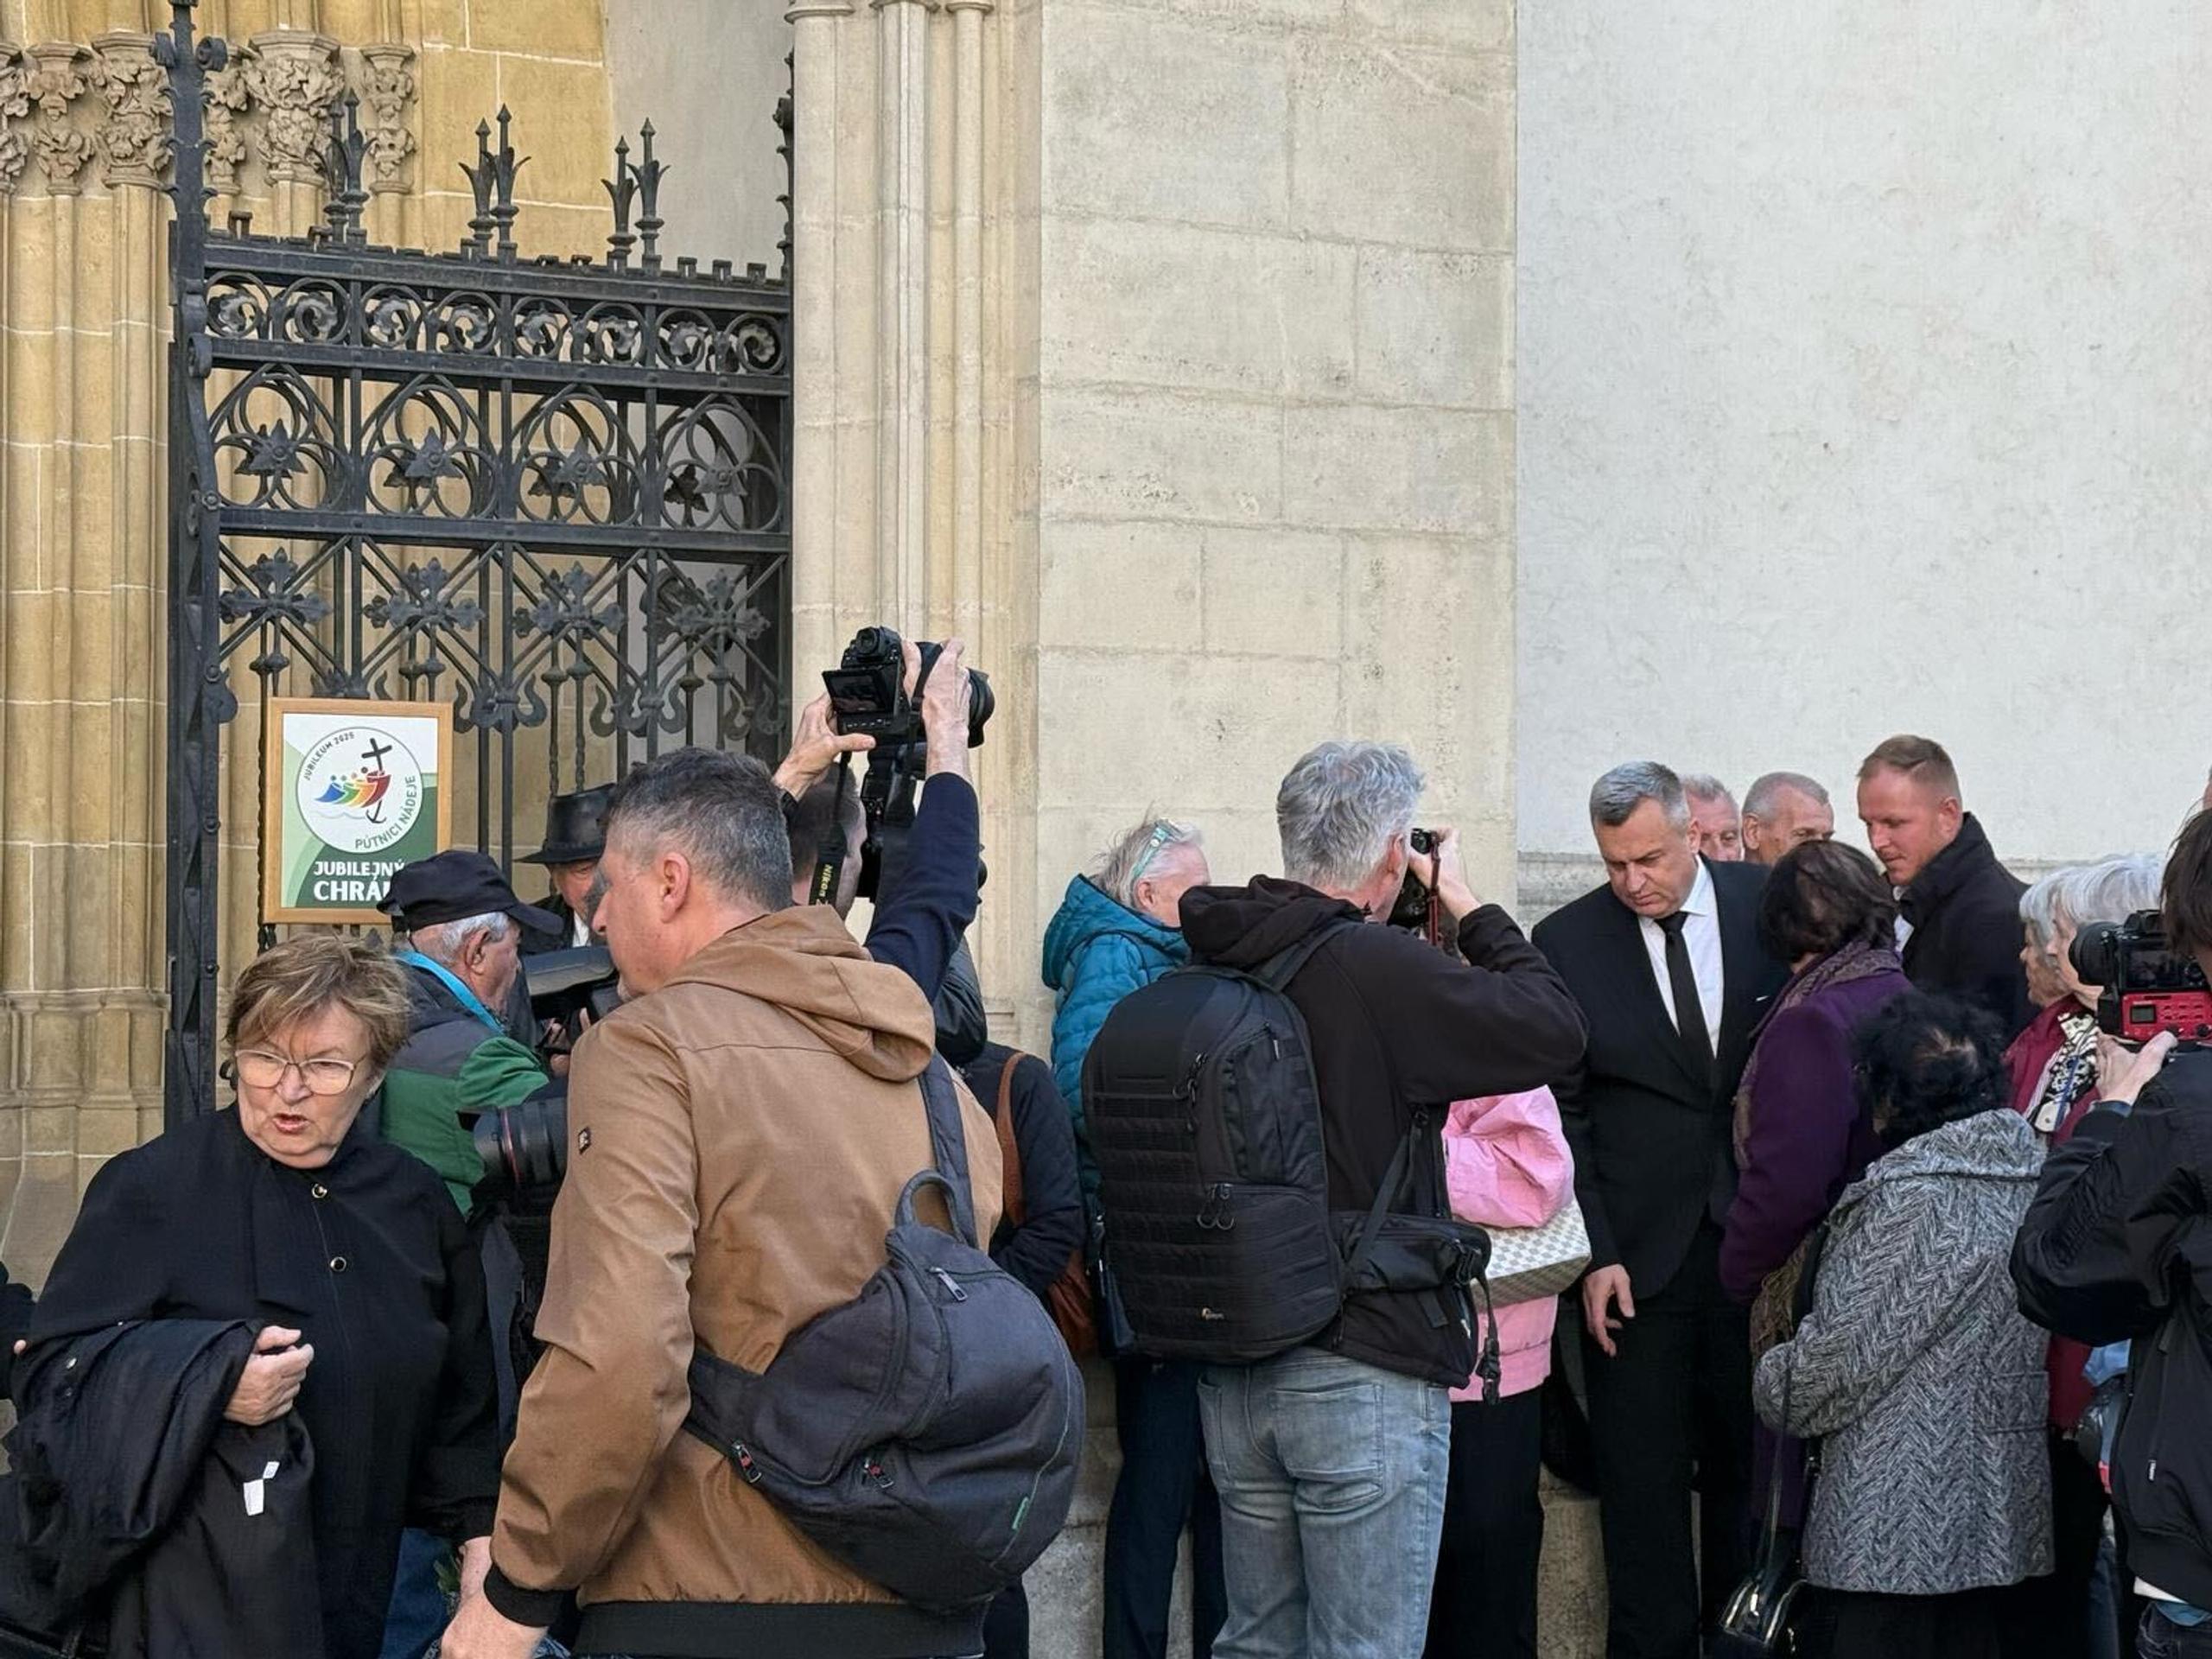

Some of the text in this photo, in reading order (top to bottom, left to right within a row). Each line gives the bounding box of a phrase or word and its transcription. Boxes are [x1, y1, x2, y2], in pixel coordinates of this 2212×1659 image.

[303, 731, 355, 781] JUBILEUM 2025
[355, 775, 417, 849] PÚTNICI NÁDEJE
